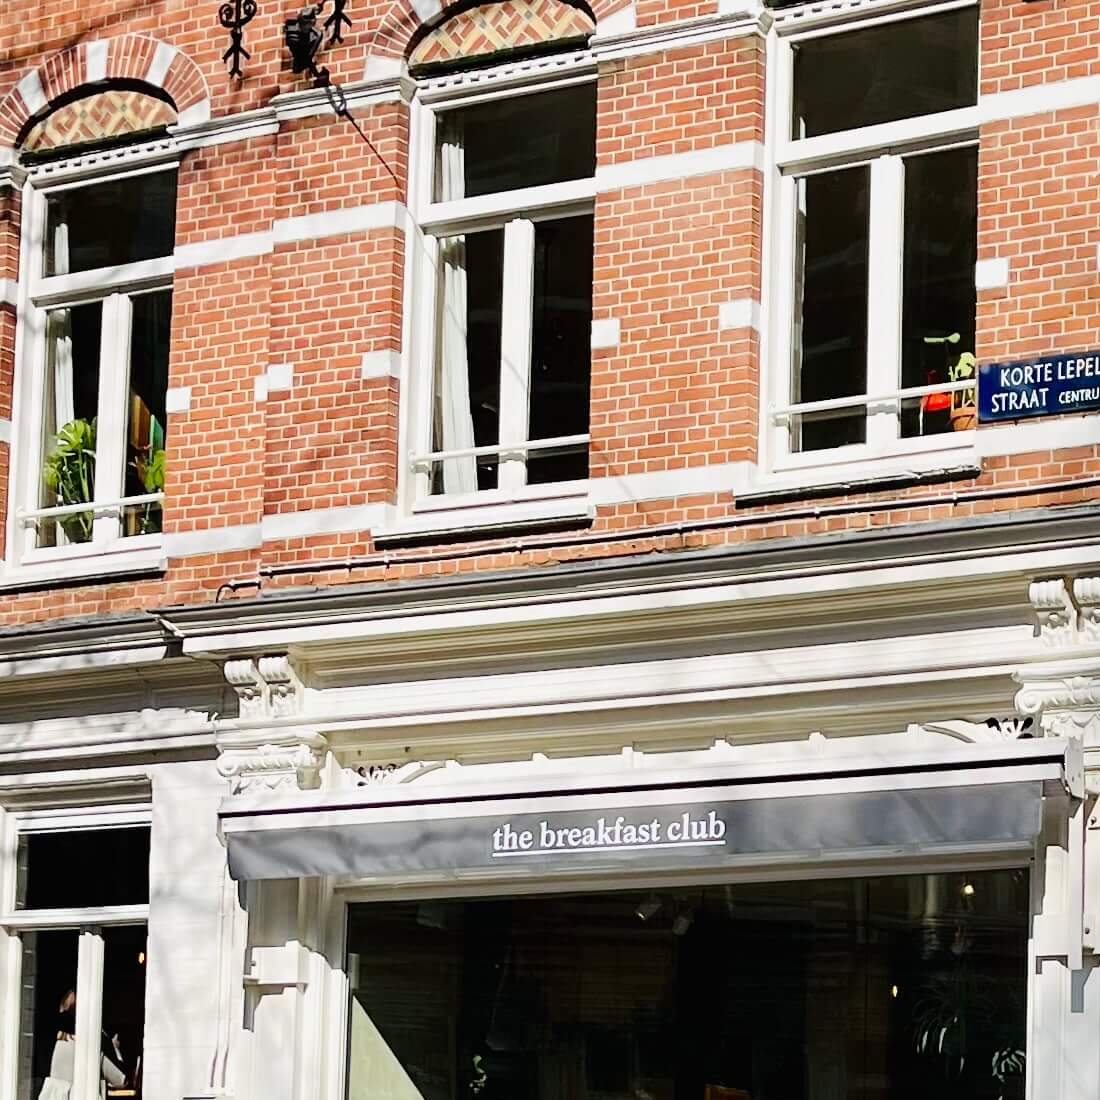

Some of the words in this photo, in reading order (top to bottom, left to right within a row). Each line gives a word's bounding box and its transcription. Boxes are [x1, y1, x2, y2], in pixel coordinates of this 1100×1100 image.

[1000, 363, 1053, 387] KORTE
[991, 388, 1049, 413] STRAAT
[493, 823, 534, 850] the
[540, 816, 661, 848] breakfast
[667, 811, 726, 840] club
